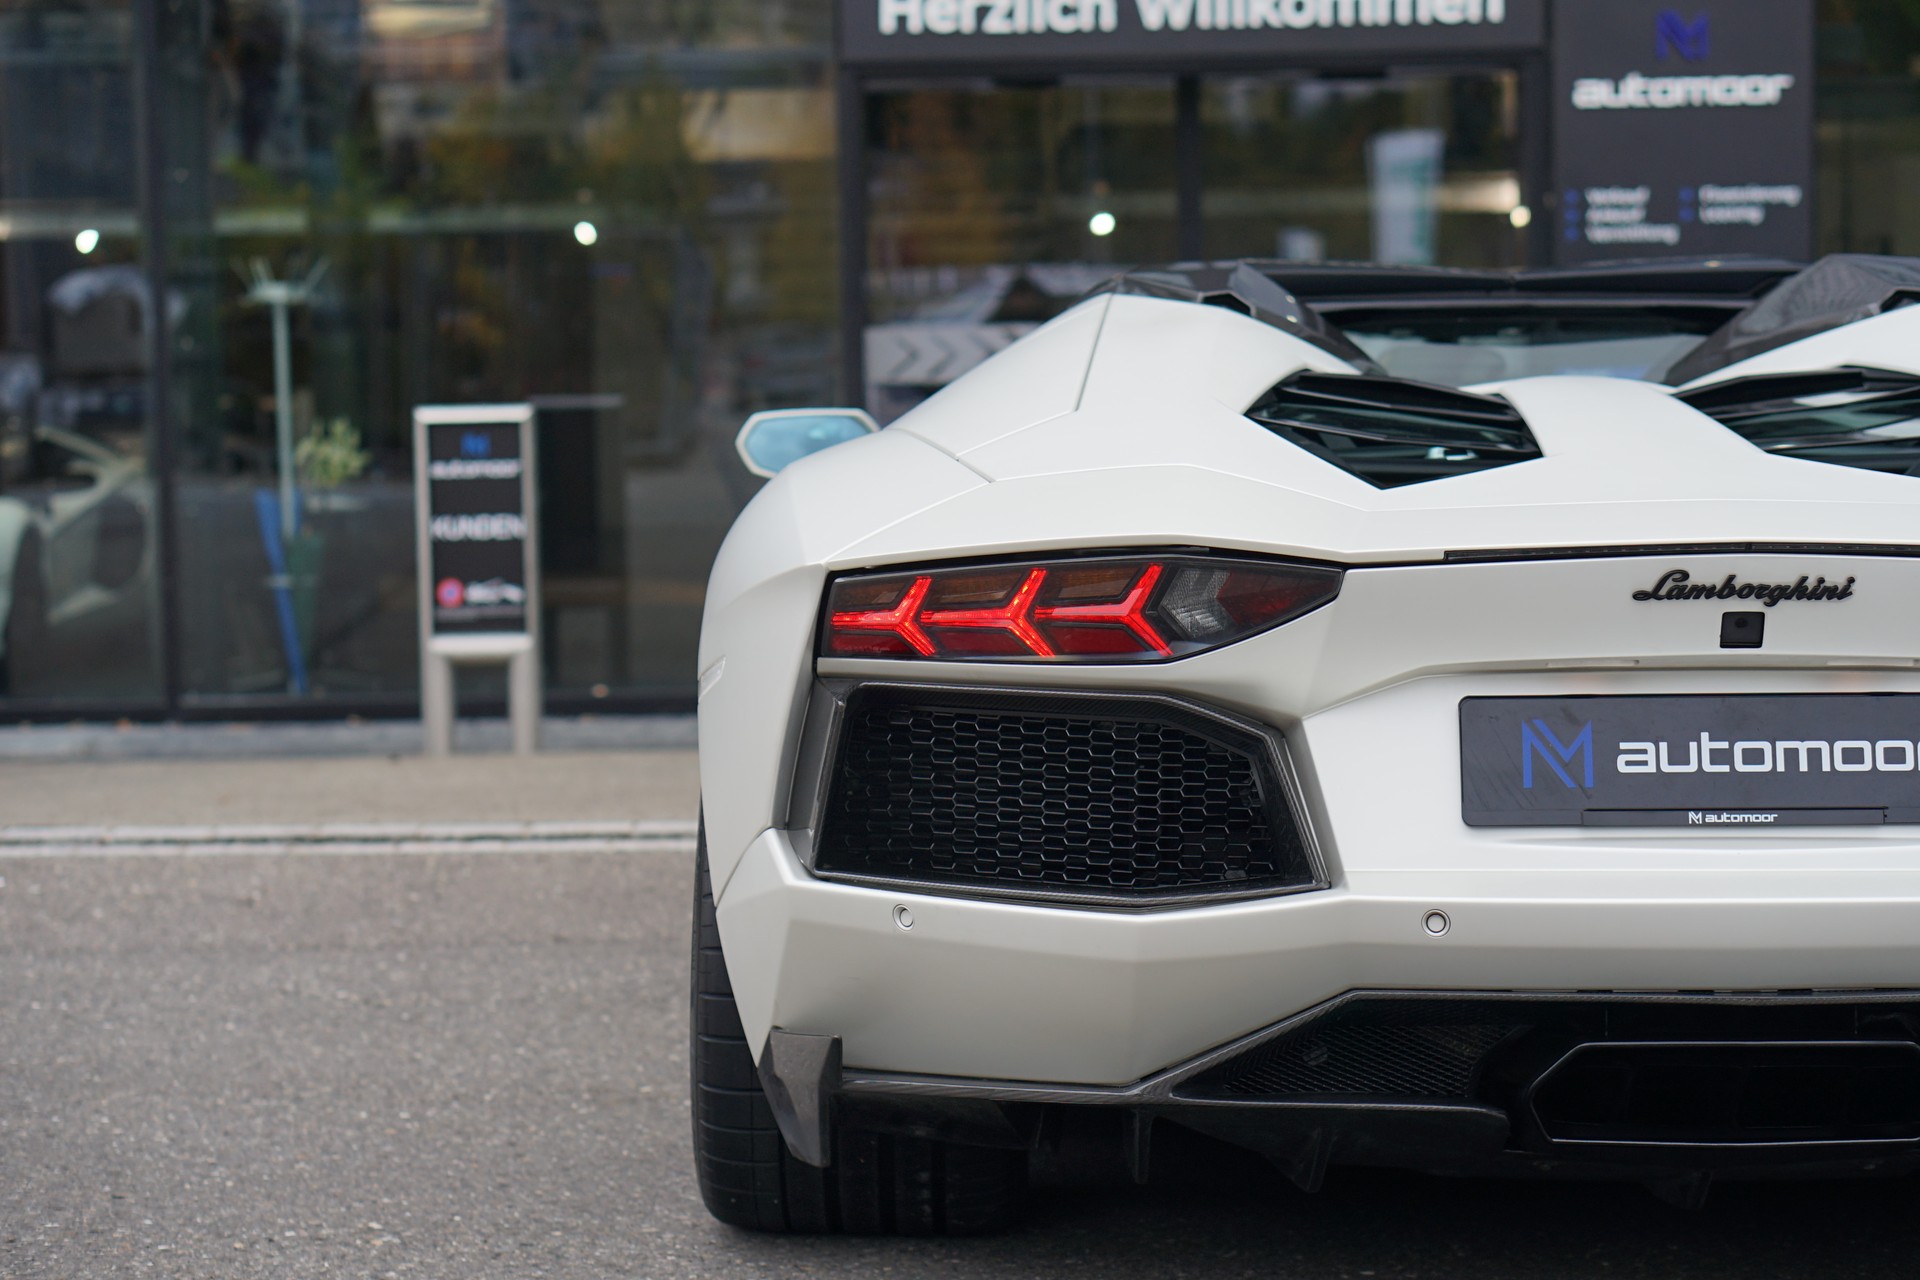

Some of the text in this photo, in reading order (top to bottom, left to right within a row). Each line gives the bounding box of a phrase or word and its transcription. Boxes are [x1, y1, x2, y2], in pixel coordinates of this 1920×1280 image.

[878, 0, 1504, 34] Herzlich Willkommen
[1572, 72, 1794, 109] automoor
[432, 513, 527, 540] KUNDEN
[1632, 569, 1857, 607] Lamborghini
[1616, 732, 1920, 773] automoo
[1705, 812, 1778, 823] automoor
